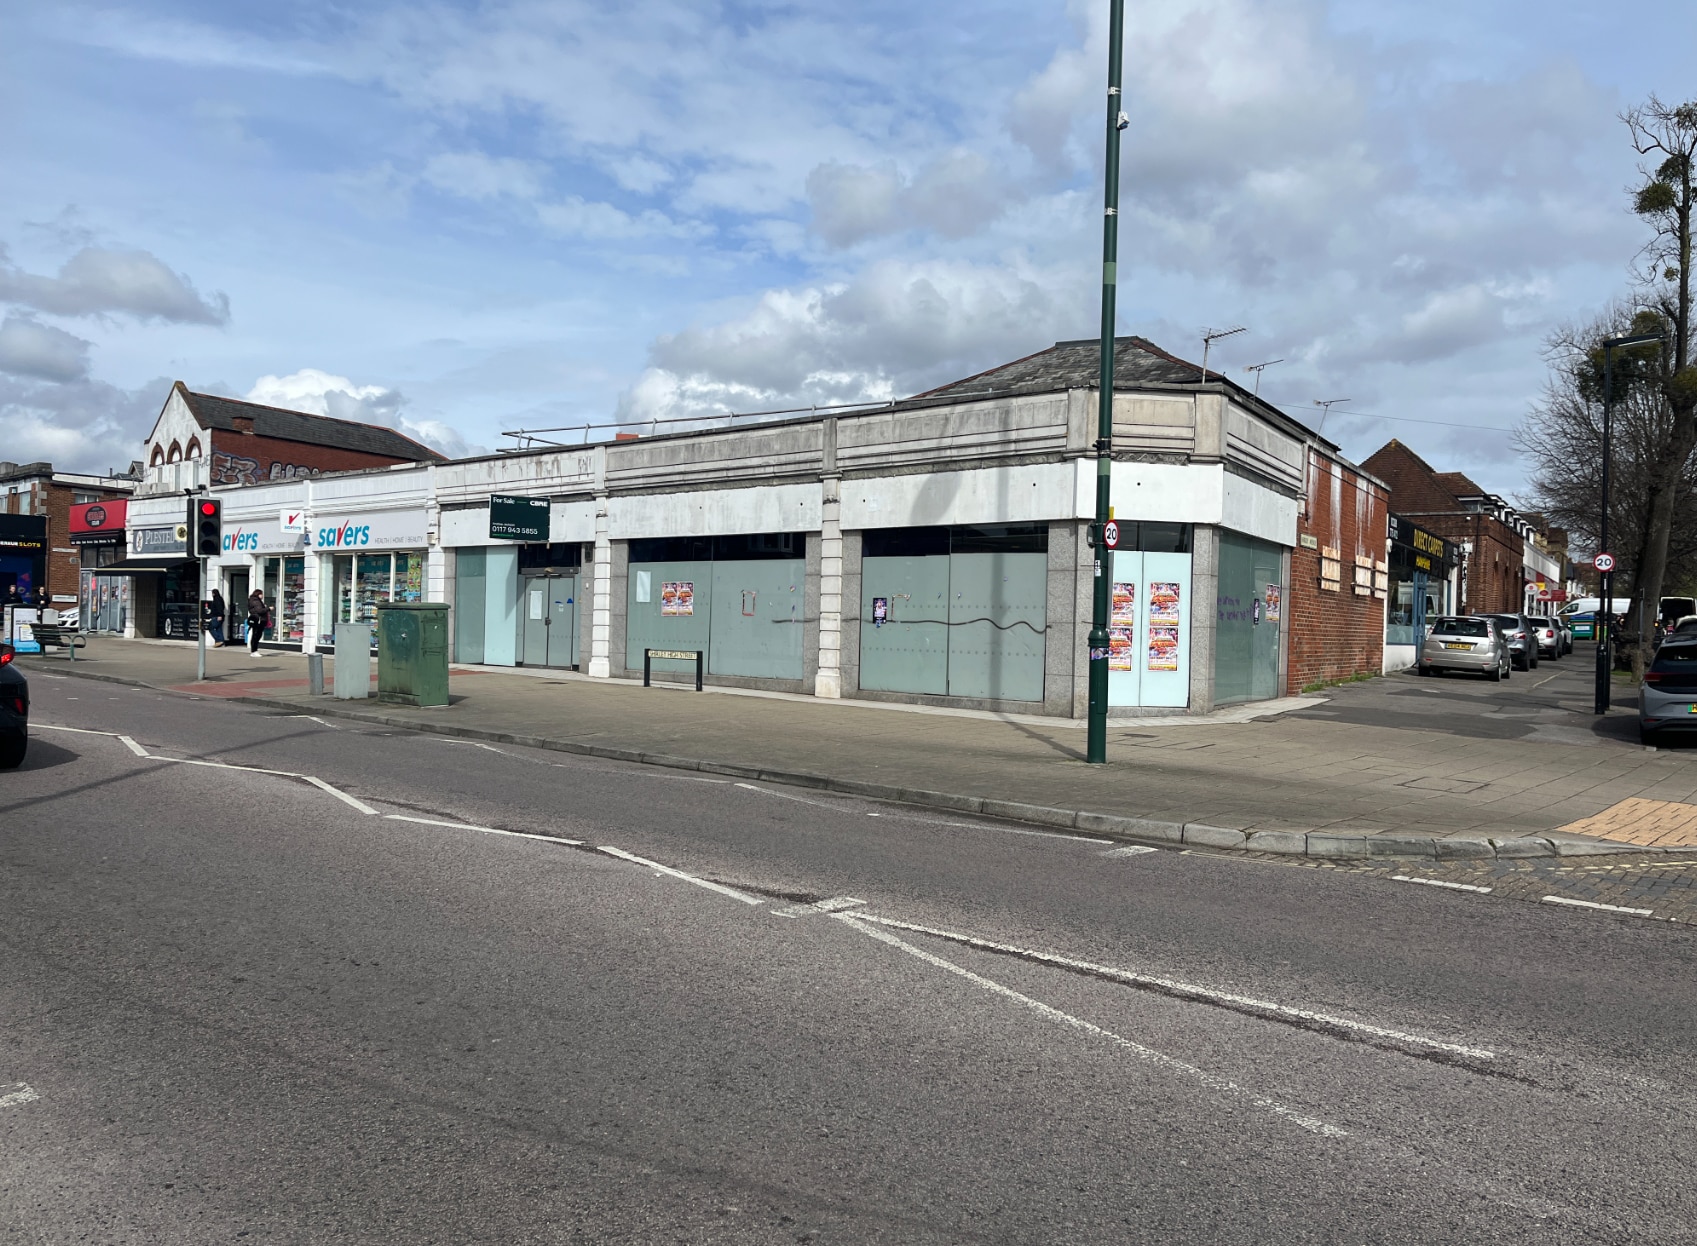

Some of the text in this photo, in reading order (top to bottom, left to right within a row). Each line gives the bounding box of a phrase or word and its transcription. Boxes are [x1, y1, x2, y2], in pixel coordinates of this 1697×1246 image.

[223, 527, 258, 551] avers
[318, 520, 370, 547] savers
[1107, 528, 1117, 540] 20
